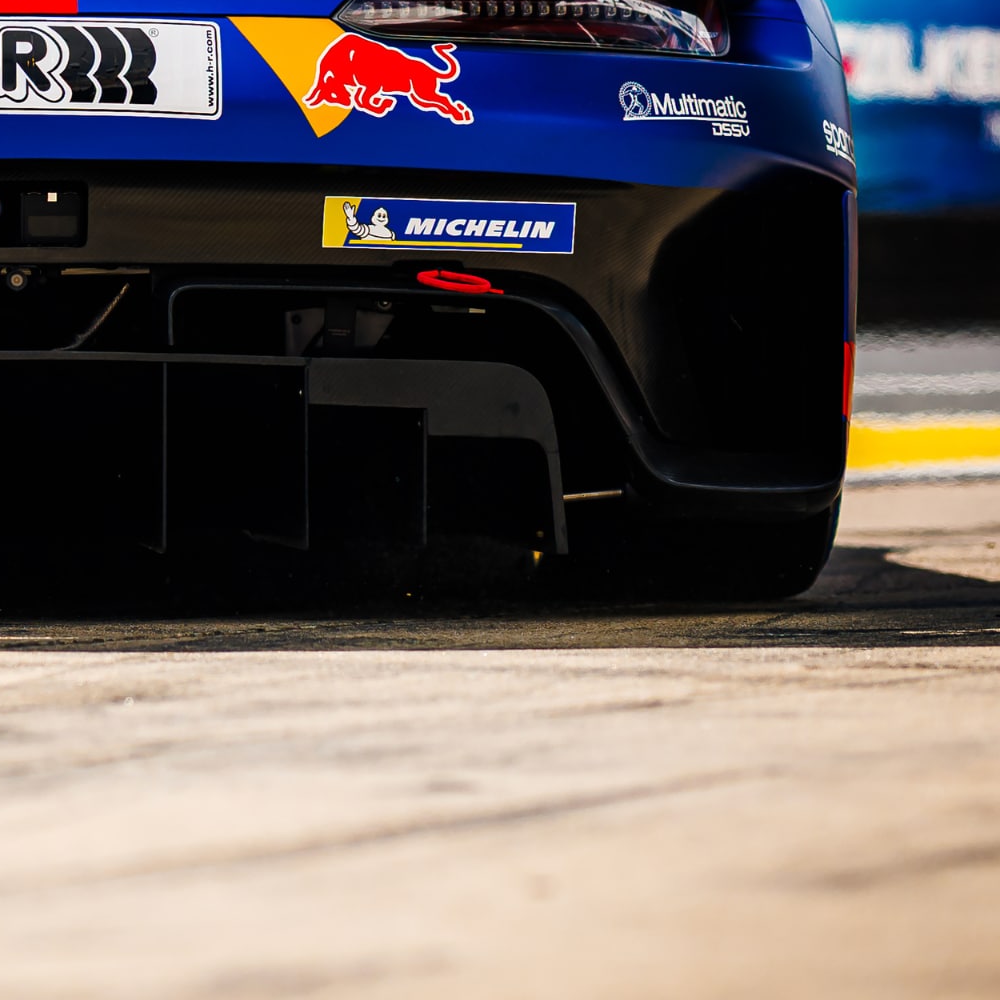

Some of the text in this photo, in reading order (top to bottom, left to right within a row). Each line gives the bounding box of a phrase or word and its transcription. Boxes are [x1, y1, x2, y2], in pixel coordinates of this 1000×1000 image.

[206, 29, 215, 107] www.h-r.com
[651, 93, 747, 119] Multimatic
[711, 122, 750, 138] DSSV
[404, 217, 555, 239] MICHELIN
